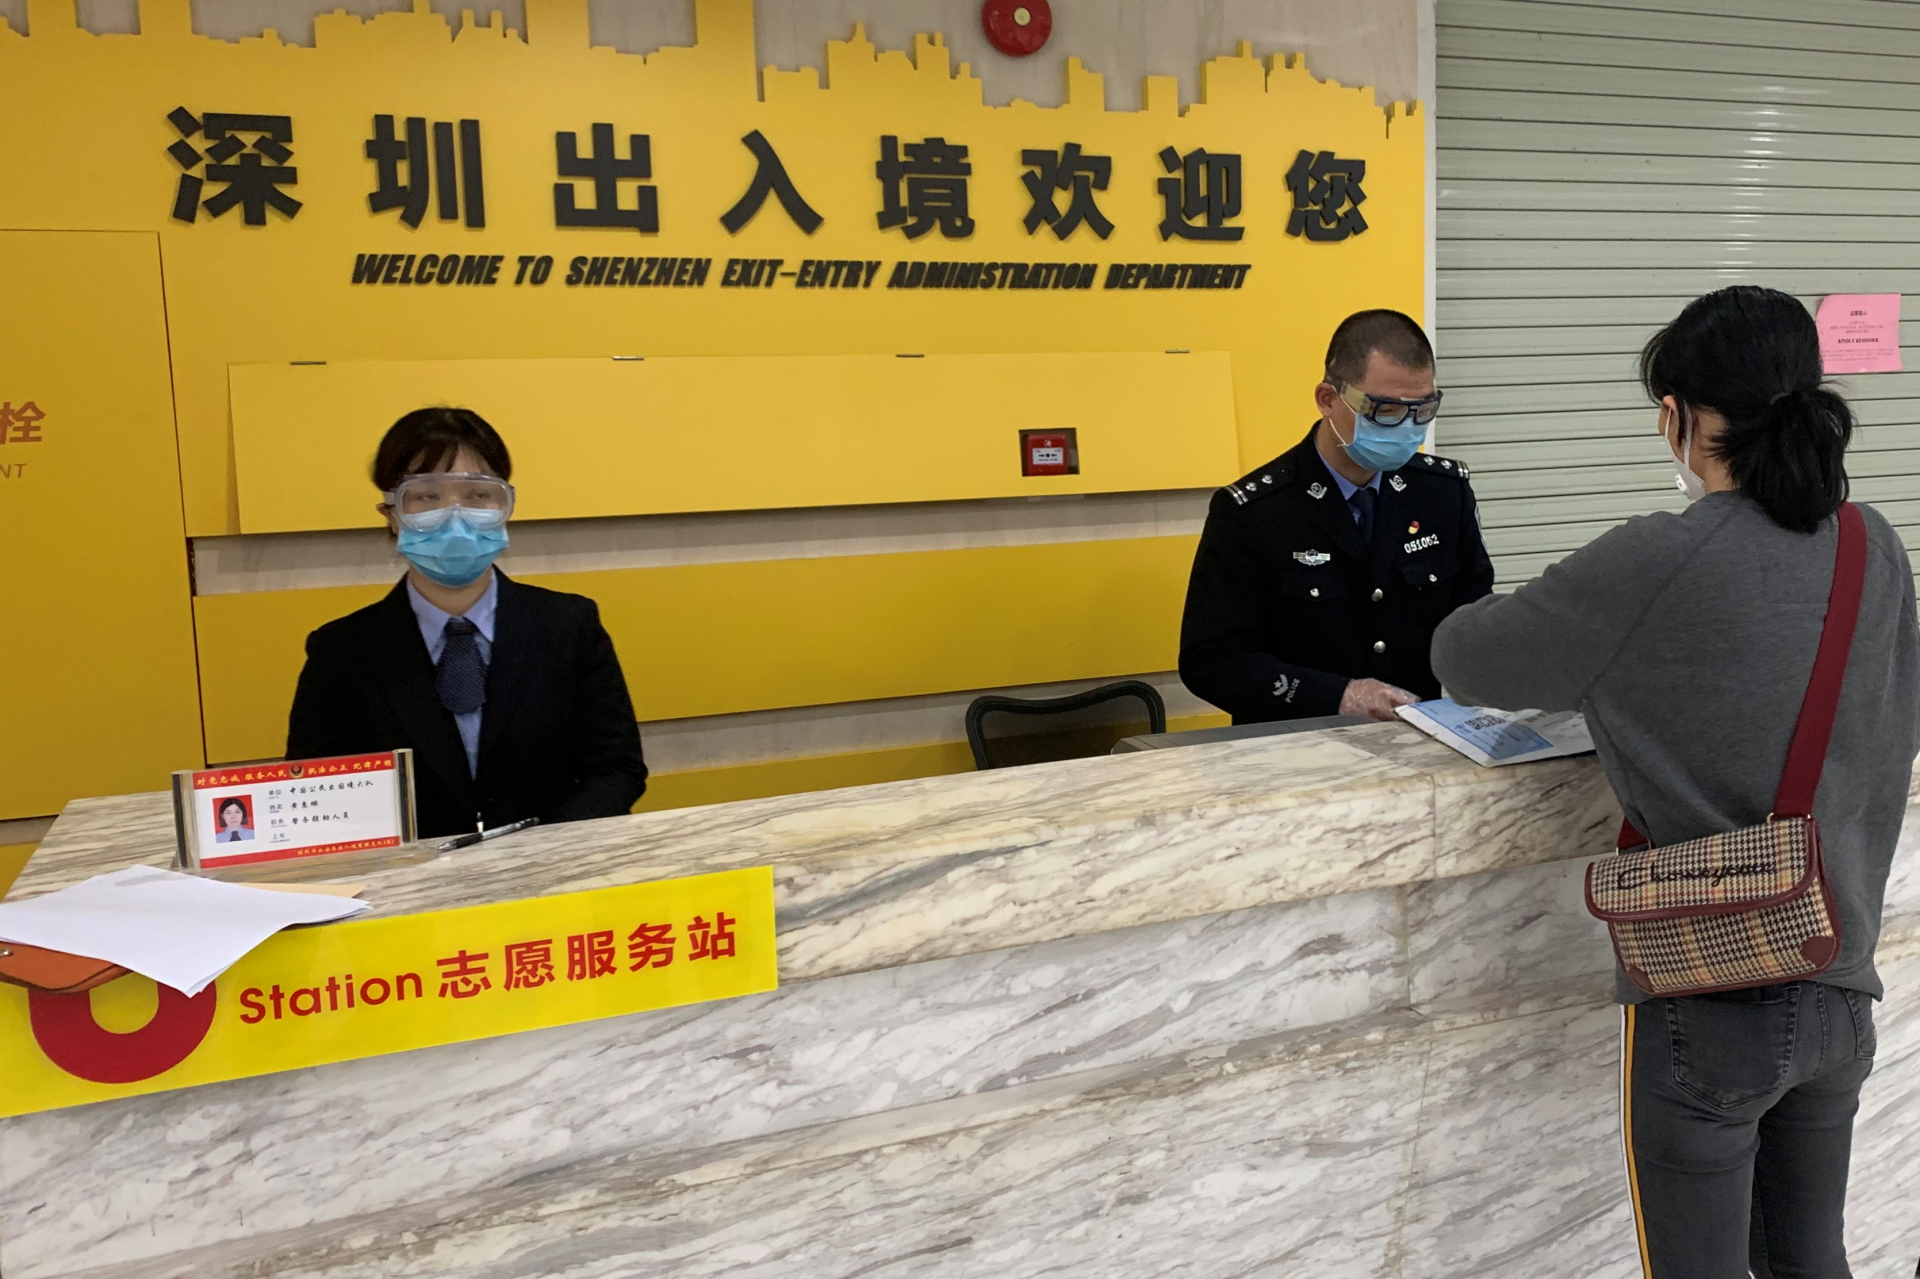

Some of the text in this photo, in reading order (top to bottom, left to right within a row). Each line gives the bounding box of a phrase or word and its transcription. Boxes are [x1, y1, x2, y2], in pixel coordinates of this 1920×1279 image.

[166, 105, 1368, 242] 深圳出入境欢迎您
[352, 253, 504, 285] WELCOME
[514, 255, 554, 286] TO
[565, 256, 712, 288] SHENZHEN
[886, 260, 1098, 290] ADMINISTRATION
[1104, 263, 1251, 290] DEPARTMENT
[1404, 533, 1440, 554] 051062
[1285, 678, 1300, 703] POLICE
[239, 972, 423, 1025] Station
[436, 911, 737, 999] 志愿服务站
